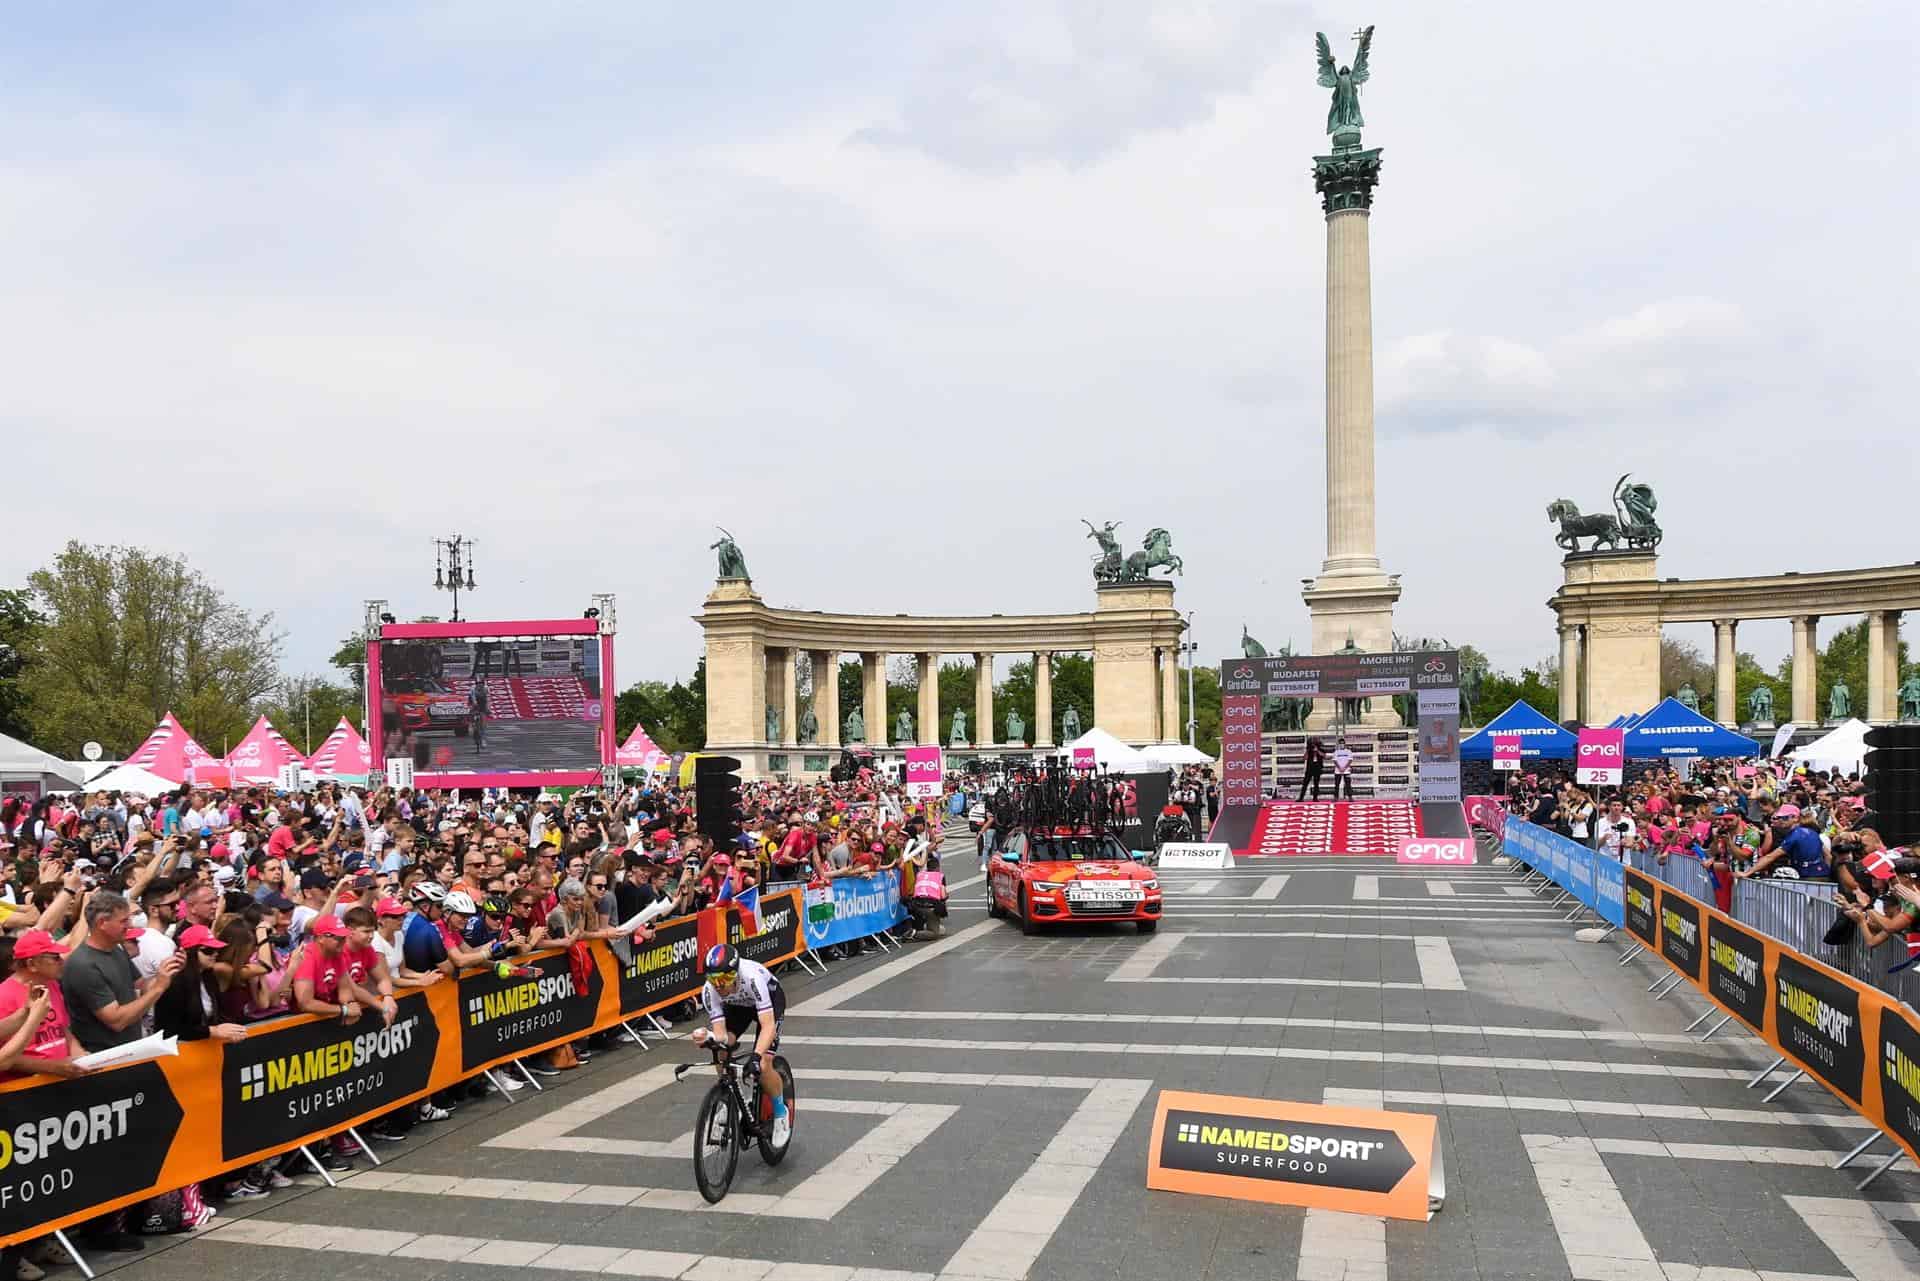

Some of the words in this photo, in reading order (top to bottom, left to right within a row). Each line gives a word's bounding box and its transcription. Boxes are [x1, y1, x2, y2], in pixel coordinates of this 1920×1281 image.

[1360, 656, 1393, 665] AMORE
[1273, 670, 1321, 679] BUDAPEST
[1285, 683, 1315, 691] TISSOT
[1375, 680, 1407, 688] TISSOT
[1226, 703, 1257, 717] enel
[1226, 722, 1257, 735] enel
[1487, 728, 1558, 737] SHIMANO
[1639, 725, 1715, 735] SHIMANO
[1226, 740, 1257, 753] enel
[1495, 743, 1519, 753] enel
[1580, 741, 1621, 757] enel
[907, 758, 939, 772] enel
[1226, 758, 1257, 771] enel
[1502, 761, 1512, 769] 10
[1226, 776, 1257, 789] enel
[1590, 771, 1609, 782] 25
[917, 785, 932, 794] 25
[1226, 794, 1257, 806] enel
[1181, 849, 1222, 857] TISSOT
[1405, 841, 1465, 860] enel
[1094, 891, 1142, 899] TISSOT
[834, 887, 885, 920] diolanum
[637, 937, 698, 977] NAMEDSPOR
[645, 967, 689, 993] SUPERFOOD
[483, 972, 576, 1021] NAMEDSPOR
[497, 1009, 563, 1042] SUPERFOOD
[1793, 1025, 1834, 1068] SUPERFOOD
[288, 1071, 384, 1119] SUPERFOOD
[1217, 1152, 1328, 1174] SUPERFOOD
[1, 1168, 74, 1209] FOOD
